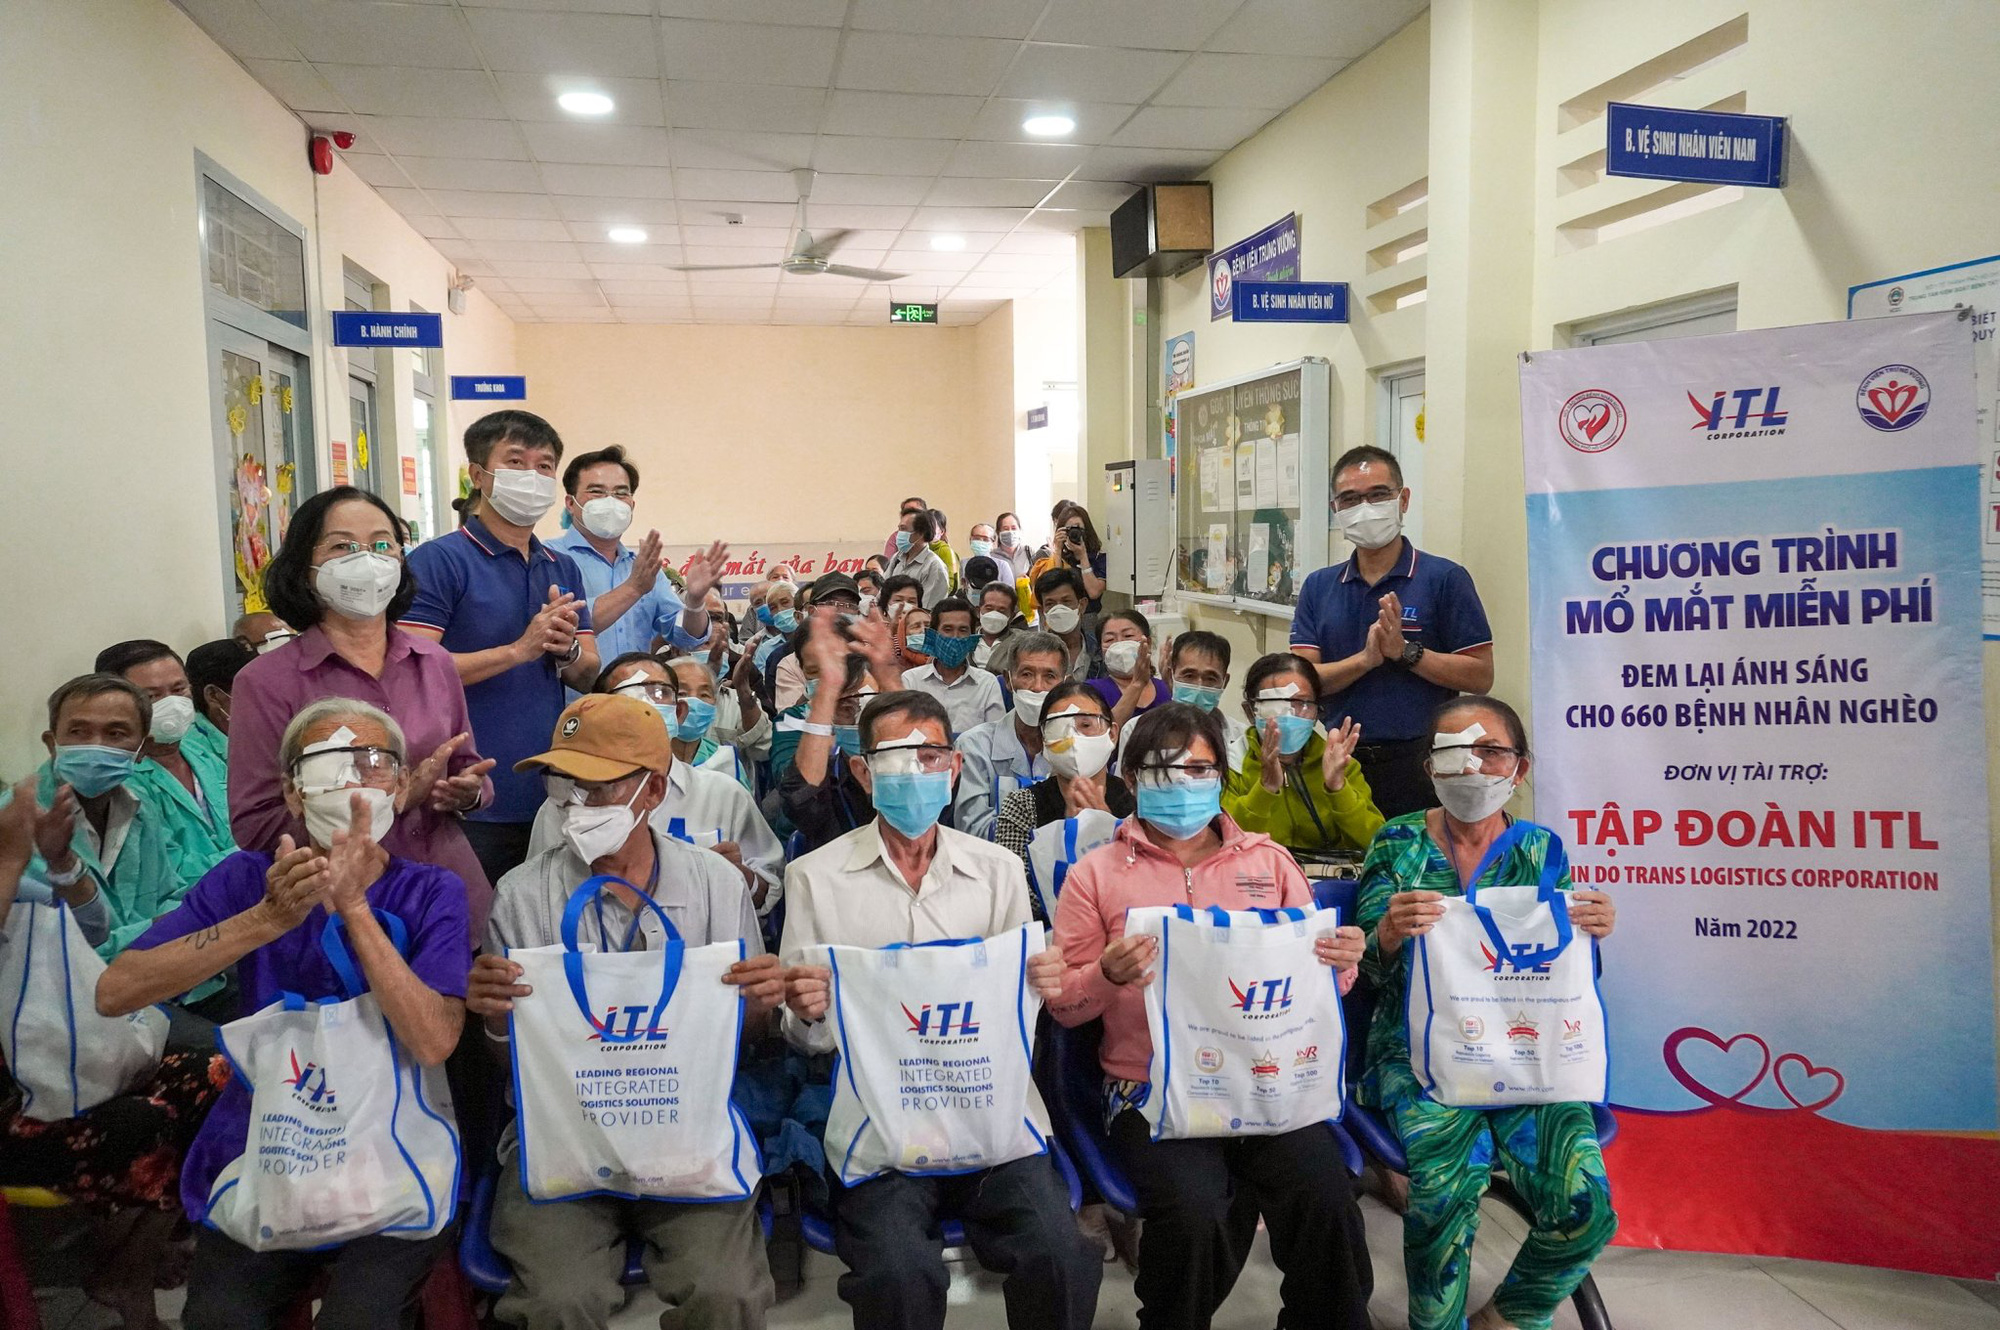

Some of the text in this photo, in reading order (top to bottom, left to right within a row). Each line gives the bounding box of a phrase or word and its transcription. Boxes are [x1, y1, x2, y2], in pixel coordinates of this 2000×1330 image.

[1625, 125, 1756, 162] B. VỆ SINH NHÂN VIÊN NAM
[1252, 294, 1259, 308] B.
[1260, 292, 1268, 311] VỆ
[1271, 294, 1286, 308] SINH
[1288, 292, 1306, 309] NHÂN
[1308, 292, 1322, 310] VIÊN
[360, 322, 418, 338] B. HÀNH CHÍNH
[1706, 428, 1786, 440] CORPORATION
[1592, 528, 1898, 582] CHƯƠNG TRÌNH
[780, 554, 816, 574] ủa
[1404, 606, 1418, 618] TL
[1566, 578, 1934, 634] MỔ MẮT MIỄN PHÍ
[1621, 654, 1868, 694] ĐEM LẠI ÁNH SÁNG
[1566, 694, 1938, 734] CHO 660 BỆNH NHÂN NGHÈO
[1664, 760, 1828, 786] ĐƠN VỊ TÀI TRỢ:
[1568, 802, 1939, 857] TẬP ĐOÀN ITL
[1570, 866, 1938, 891] IN DO TRANS LOGISTICS CORPORATION
[1694, 917, 1798, 940] Năm 2022
[600, 1044, 666, 1052] CORPORATION
[920, 1036, 979, 1045] CORPORATION
[899, 1056, 991, 1068] LEADING REGIONAL
[576, 1066, 679, 1079] LEADING REGIONAL
[900, 1066, 992, 1083] INTEGRATED
[576, 1079, 680, 1096] INTEGRATED
[900, 1082, 994, 1094] LOGISTICS SOLUTIONS
[579, 1097, 679, 1108] OGISTICS SOLUTIONS
[902, 1094, 994, 1112] PROVIDER
[262, 1113, 302, 1128] LEADING
